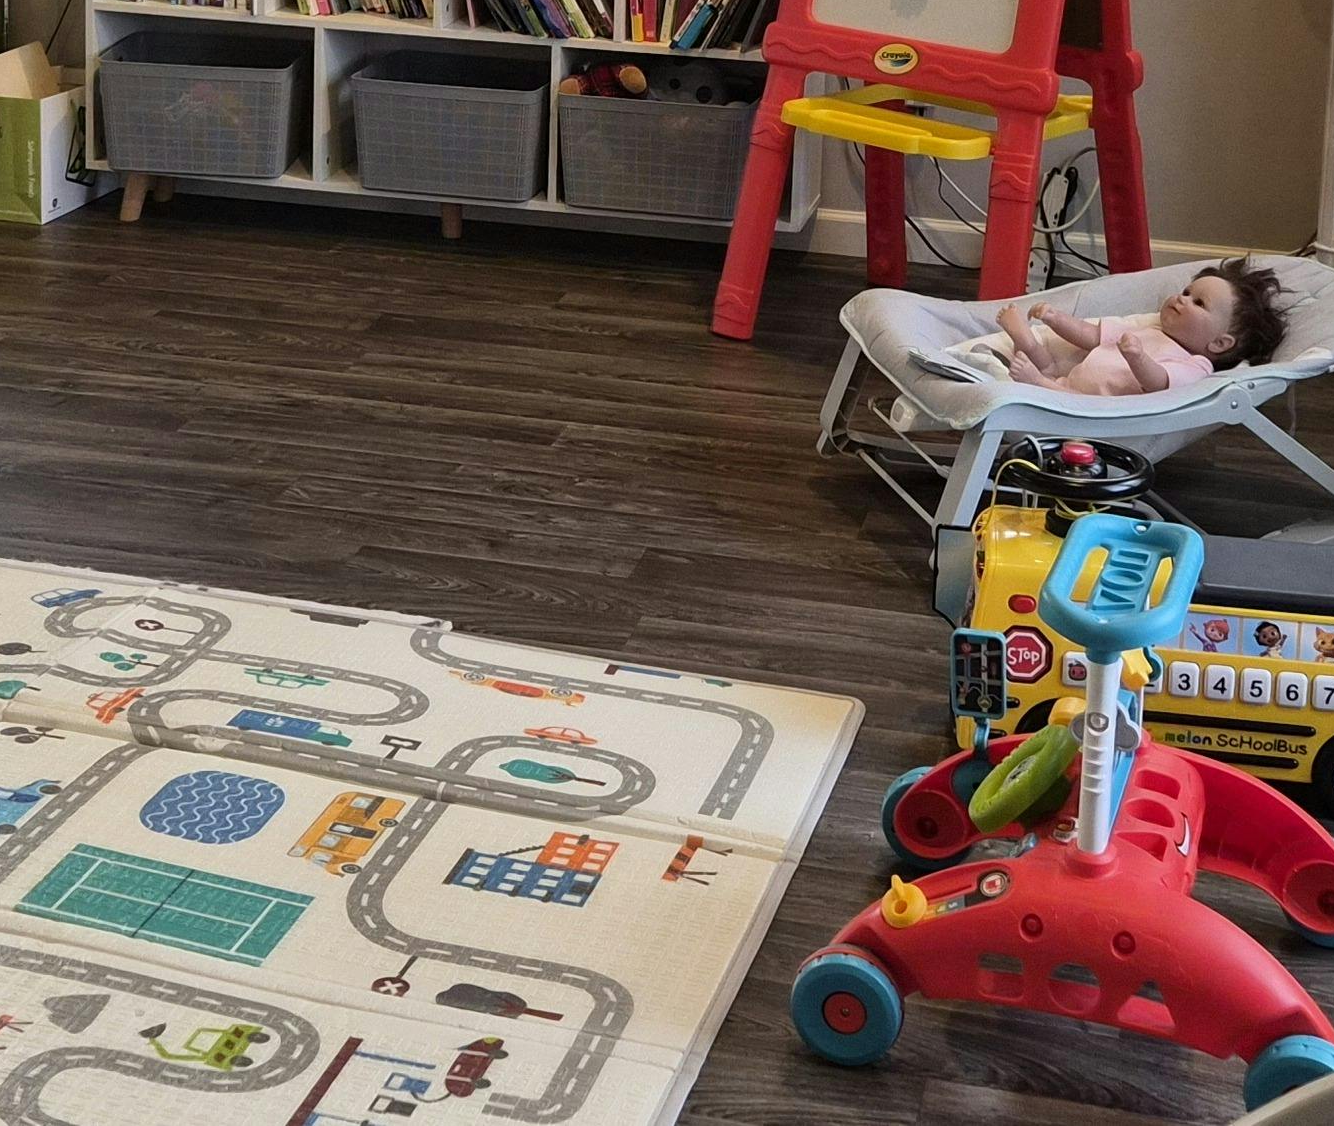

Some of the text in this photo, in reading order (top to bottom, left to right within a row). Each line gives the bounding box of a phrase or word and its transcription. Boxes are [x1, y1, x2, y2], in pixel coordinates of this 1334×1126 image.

[881, 50, 912, 61] Crayola
[1177, 673, 1191, 691] 3
[1212, 676, 1227, 695] 4
[1249, 680, 1263, 698] 5
[1285, 684, 1299, 702] 6
